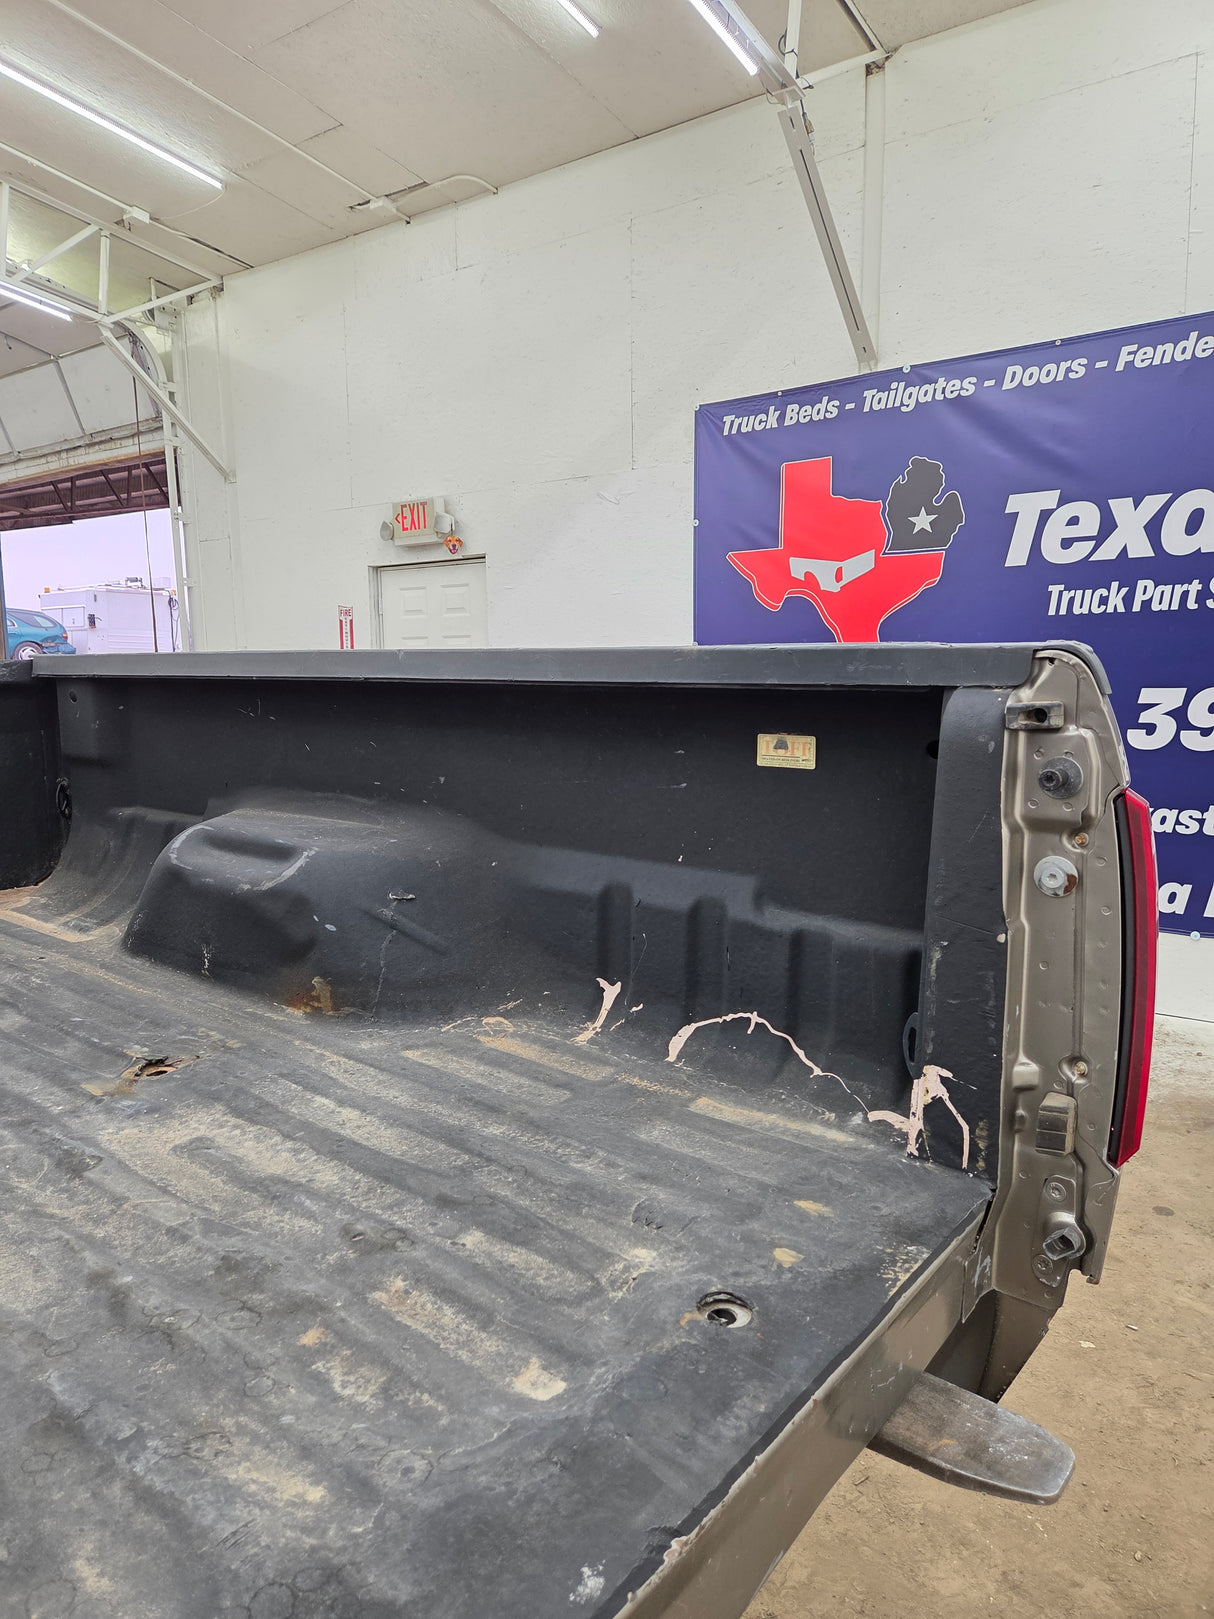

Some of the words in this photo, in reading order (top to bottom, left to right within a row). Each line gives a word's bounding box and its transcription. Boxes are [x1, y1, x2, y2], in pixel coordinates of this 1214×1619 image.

[722, 406, 781, 436] Truck
[784, 395, 840, 426] Beds
[862, 376, 978, 413] Tailgates
[1001, 357, 1088, 390] Doors
[1115, 331, 1214, 372] Fende
[400, 501, 428, 532] EXIT
[1004, 488, 1214, 567] Texa
[339, 607, 352, 617] FIRE
[1047, 581, 1130, 616] Truck
[1131, 579, 1203, 612] Part
[1126, 687, 1214, 752] 39
[1149, 805, 1214, 836] ast
